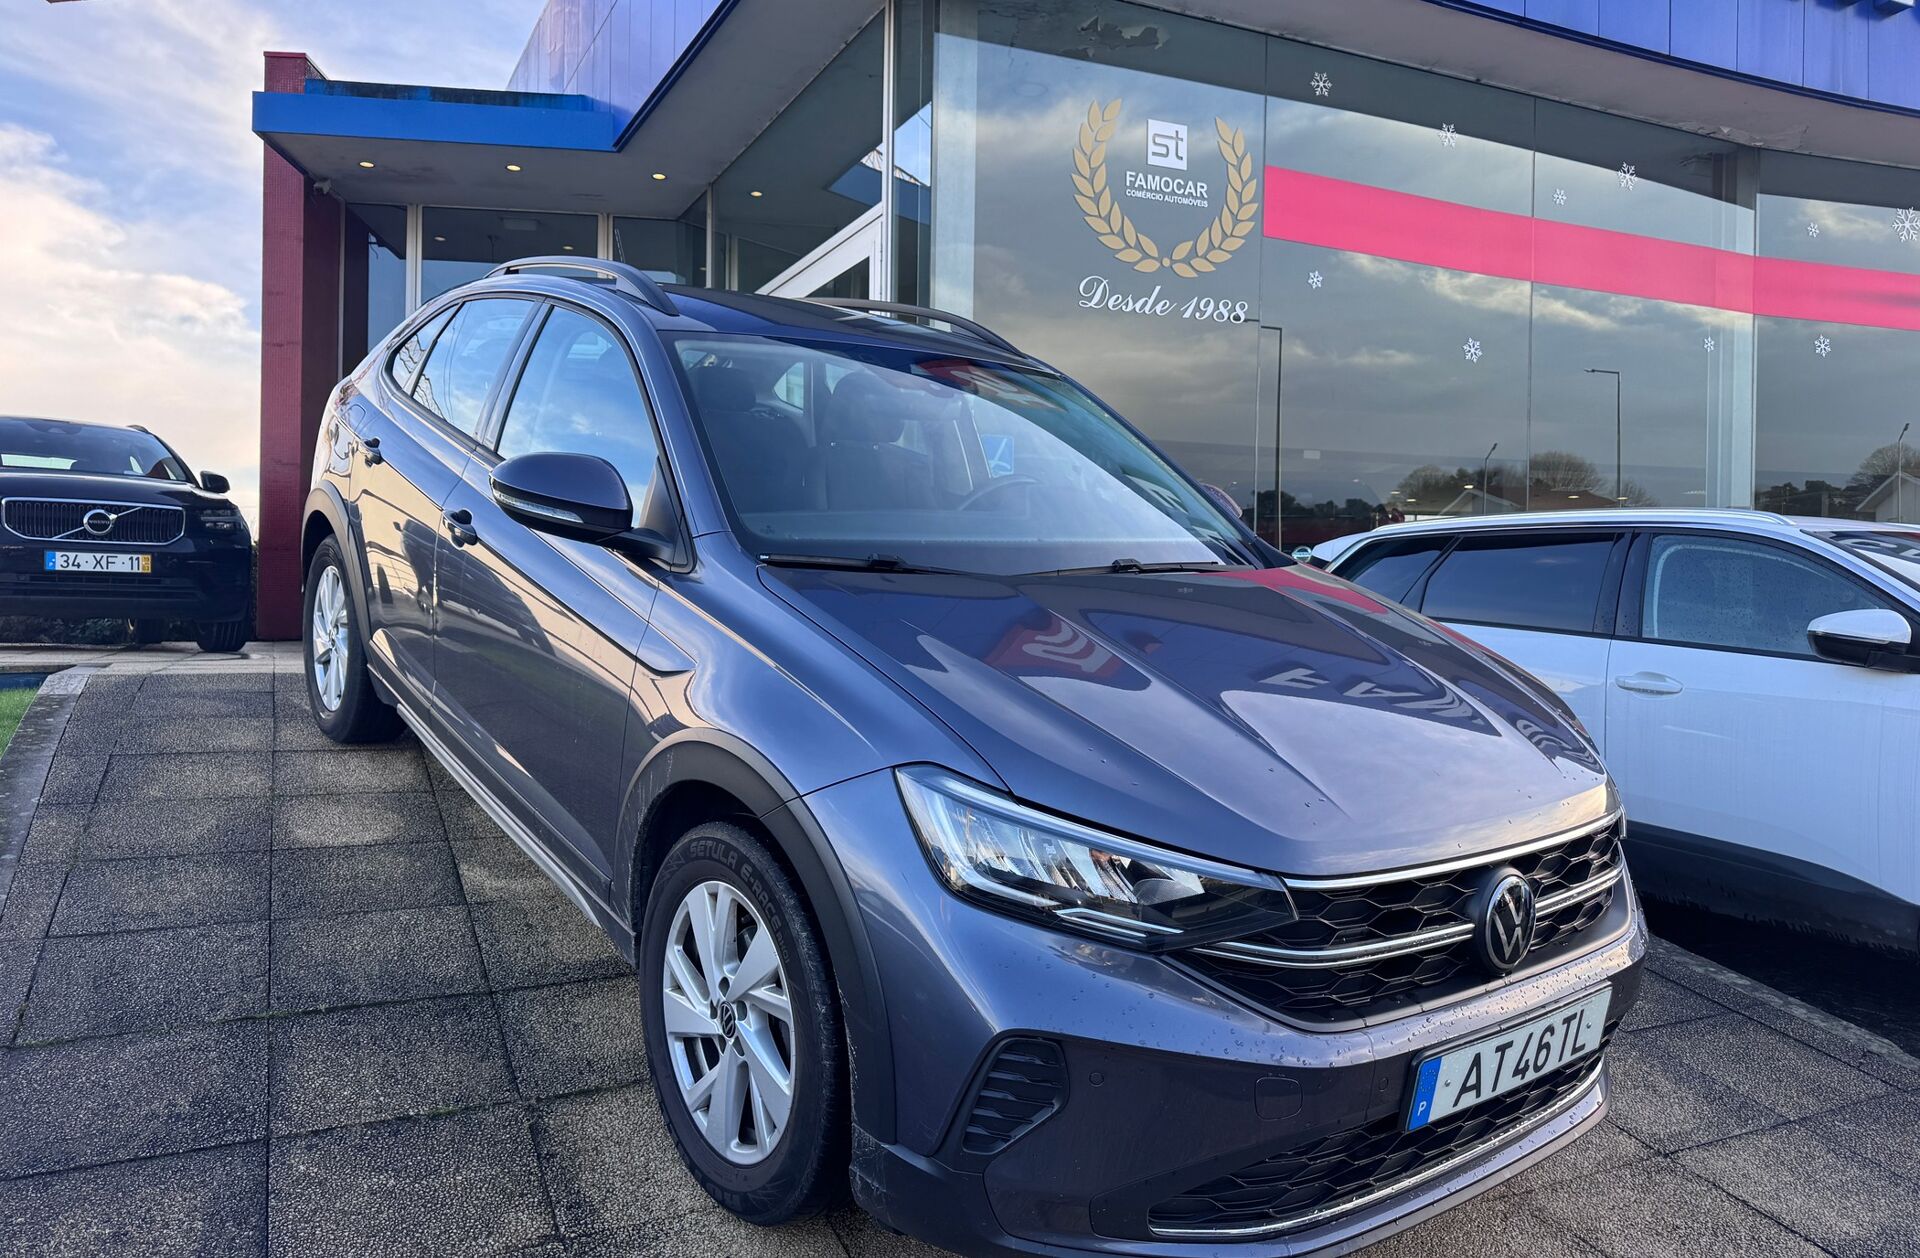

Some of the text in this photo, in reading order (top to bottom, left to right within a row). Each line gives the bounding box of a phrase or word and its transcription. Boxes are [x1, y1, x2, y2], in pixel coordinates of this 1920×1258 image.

[1151, 130, 1184, 161] st
[1125, 171, 1208, 198] FAMOCAR
[1126, 188, 1208, 208] COMÉRCIO AUTOMÓVEIS
[1078, 275, 1248, 324] Desde 1988
[1417, 1101, 1427, 1116] P
